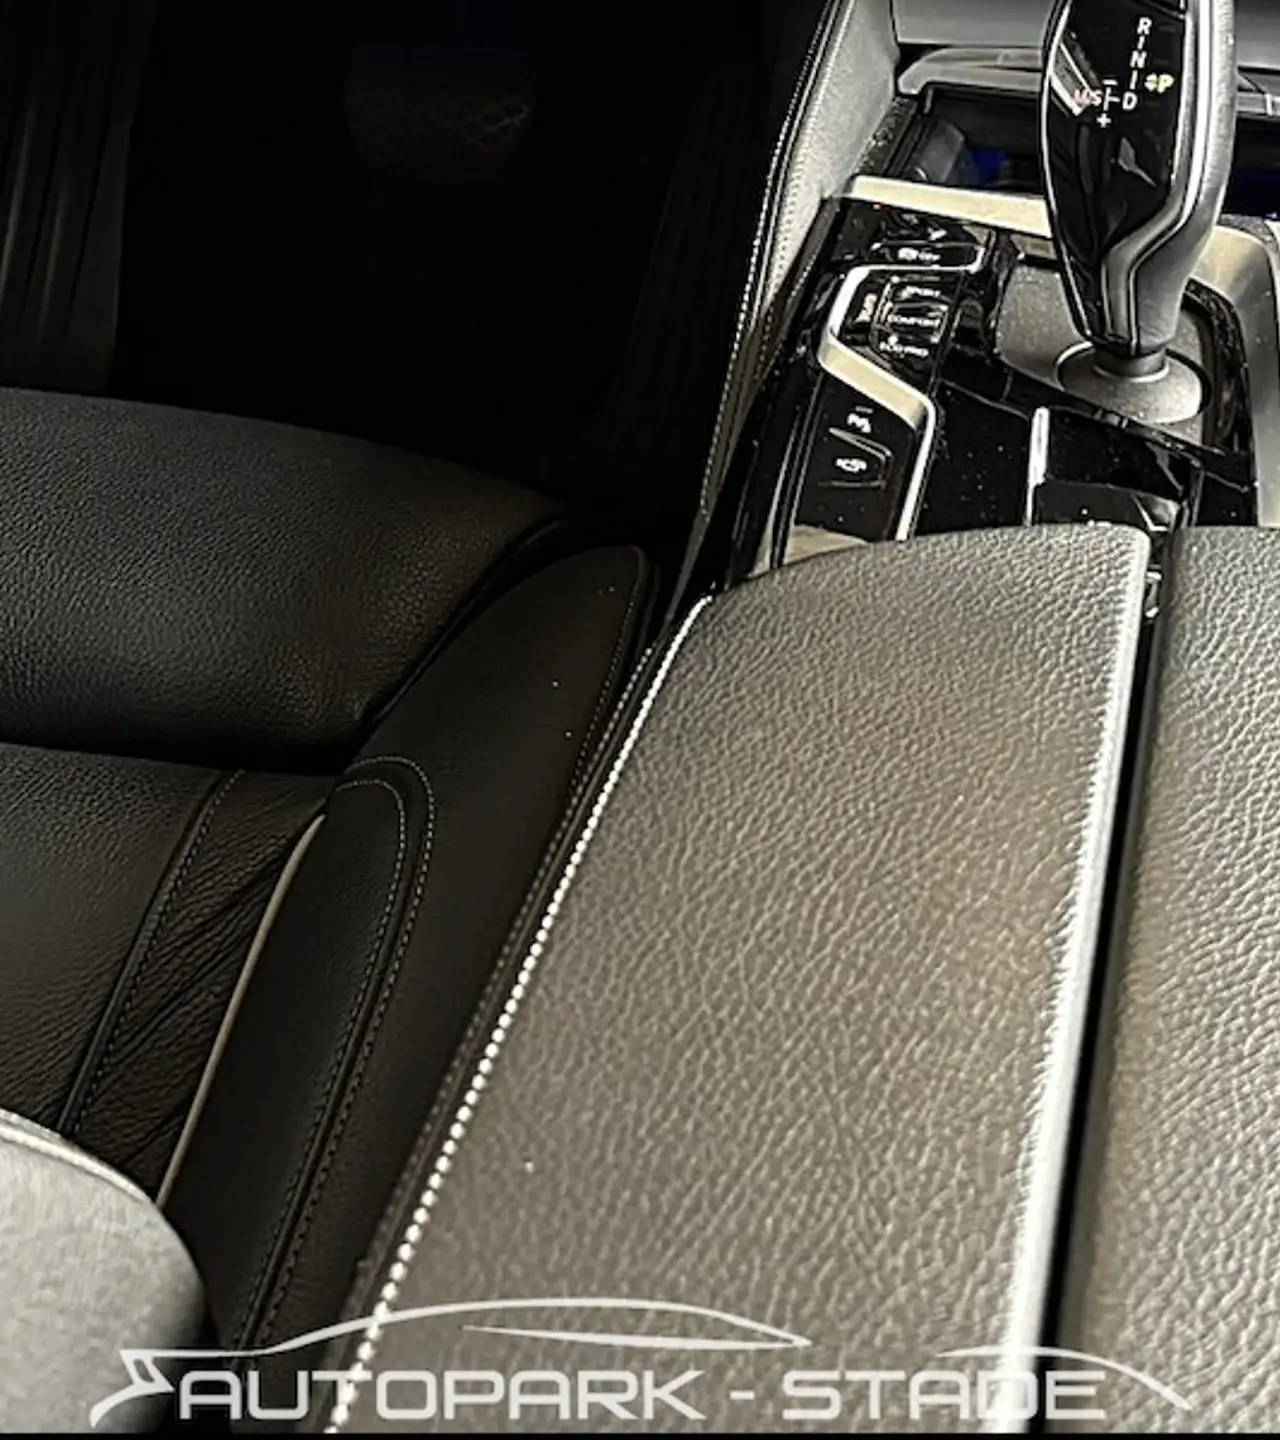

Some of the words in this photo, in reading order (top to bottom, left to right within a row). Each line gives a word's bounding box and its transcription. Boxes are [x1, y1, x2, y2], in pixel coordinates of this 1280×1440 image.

[1136, 16, 1153, 35] R
[1129, 50, 1147, 69] N
[1122, 91, 1139, 110] D
[887, 315, 942, 328] COMFORT
